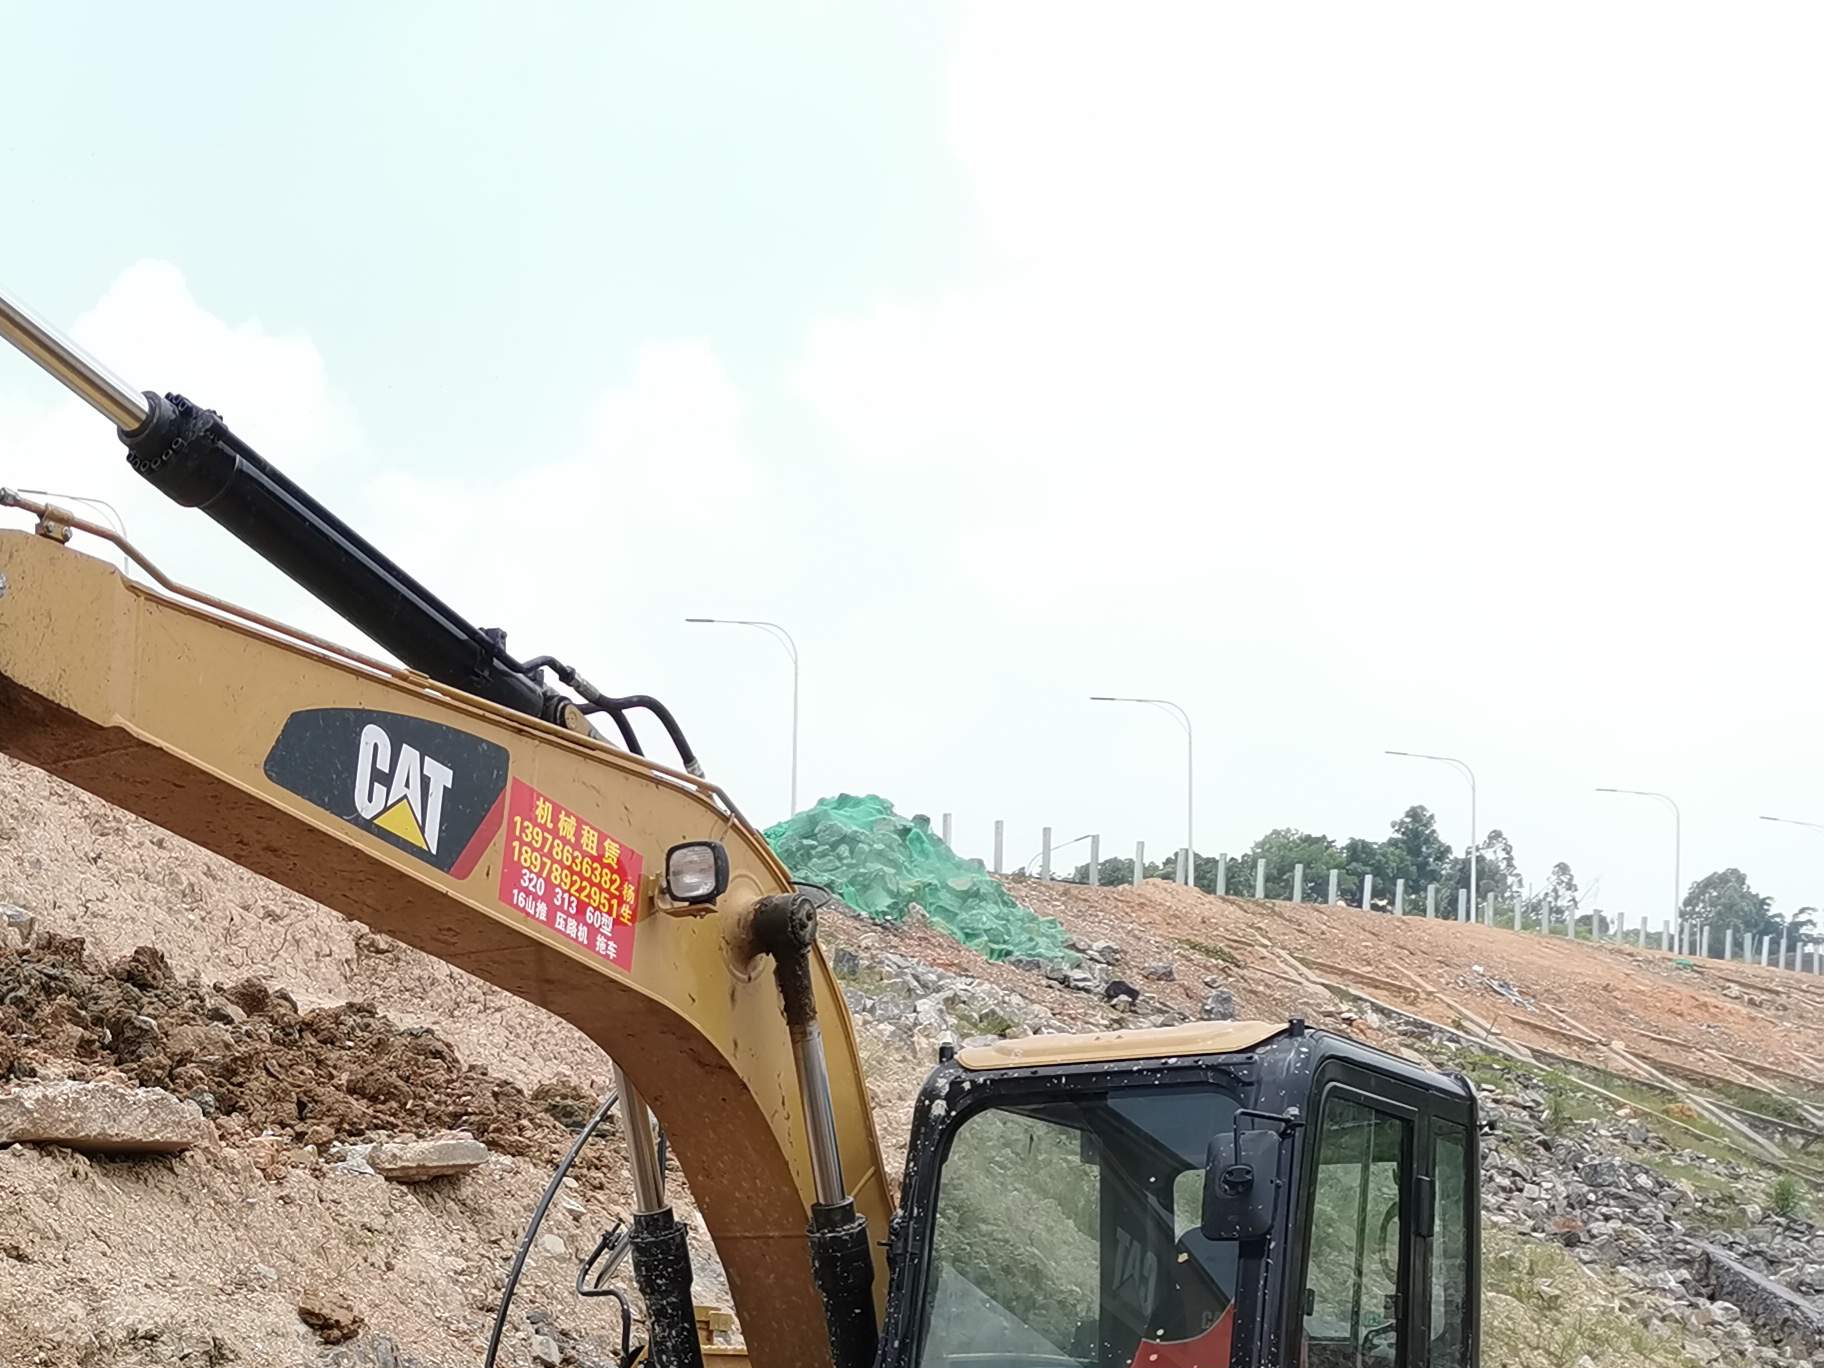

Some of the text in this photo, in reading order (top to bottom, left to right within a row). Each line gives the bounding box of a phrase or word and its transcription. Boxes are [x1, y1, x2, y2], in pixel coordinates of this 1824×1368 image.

[354, 723, 454, 855] CAT
[513, 815, 621, 896] 13978636382
[535, 797, 621, 869] 机械租赁
[512, 840, 619, 918] 18978922951
[520, 869, 614, 936] 320 313 60型
[554, 911, 588, 944] 压路机
